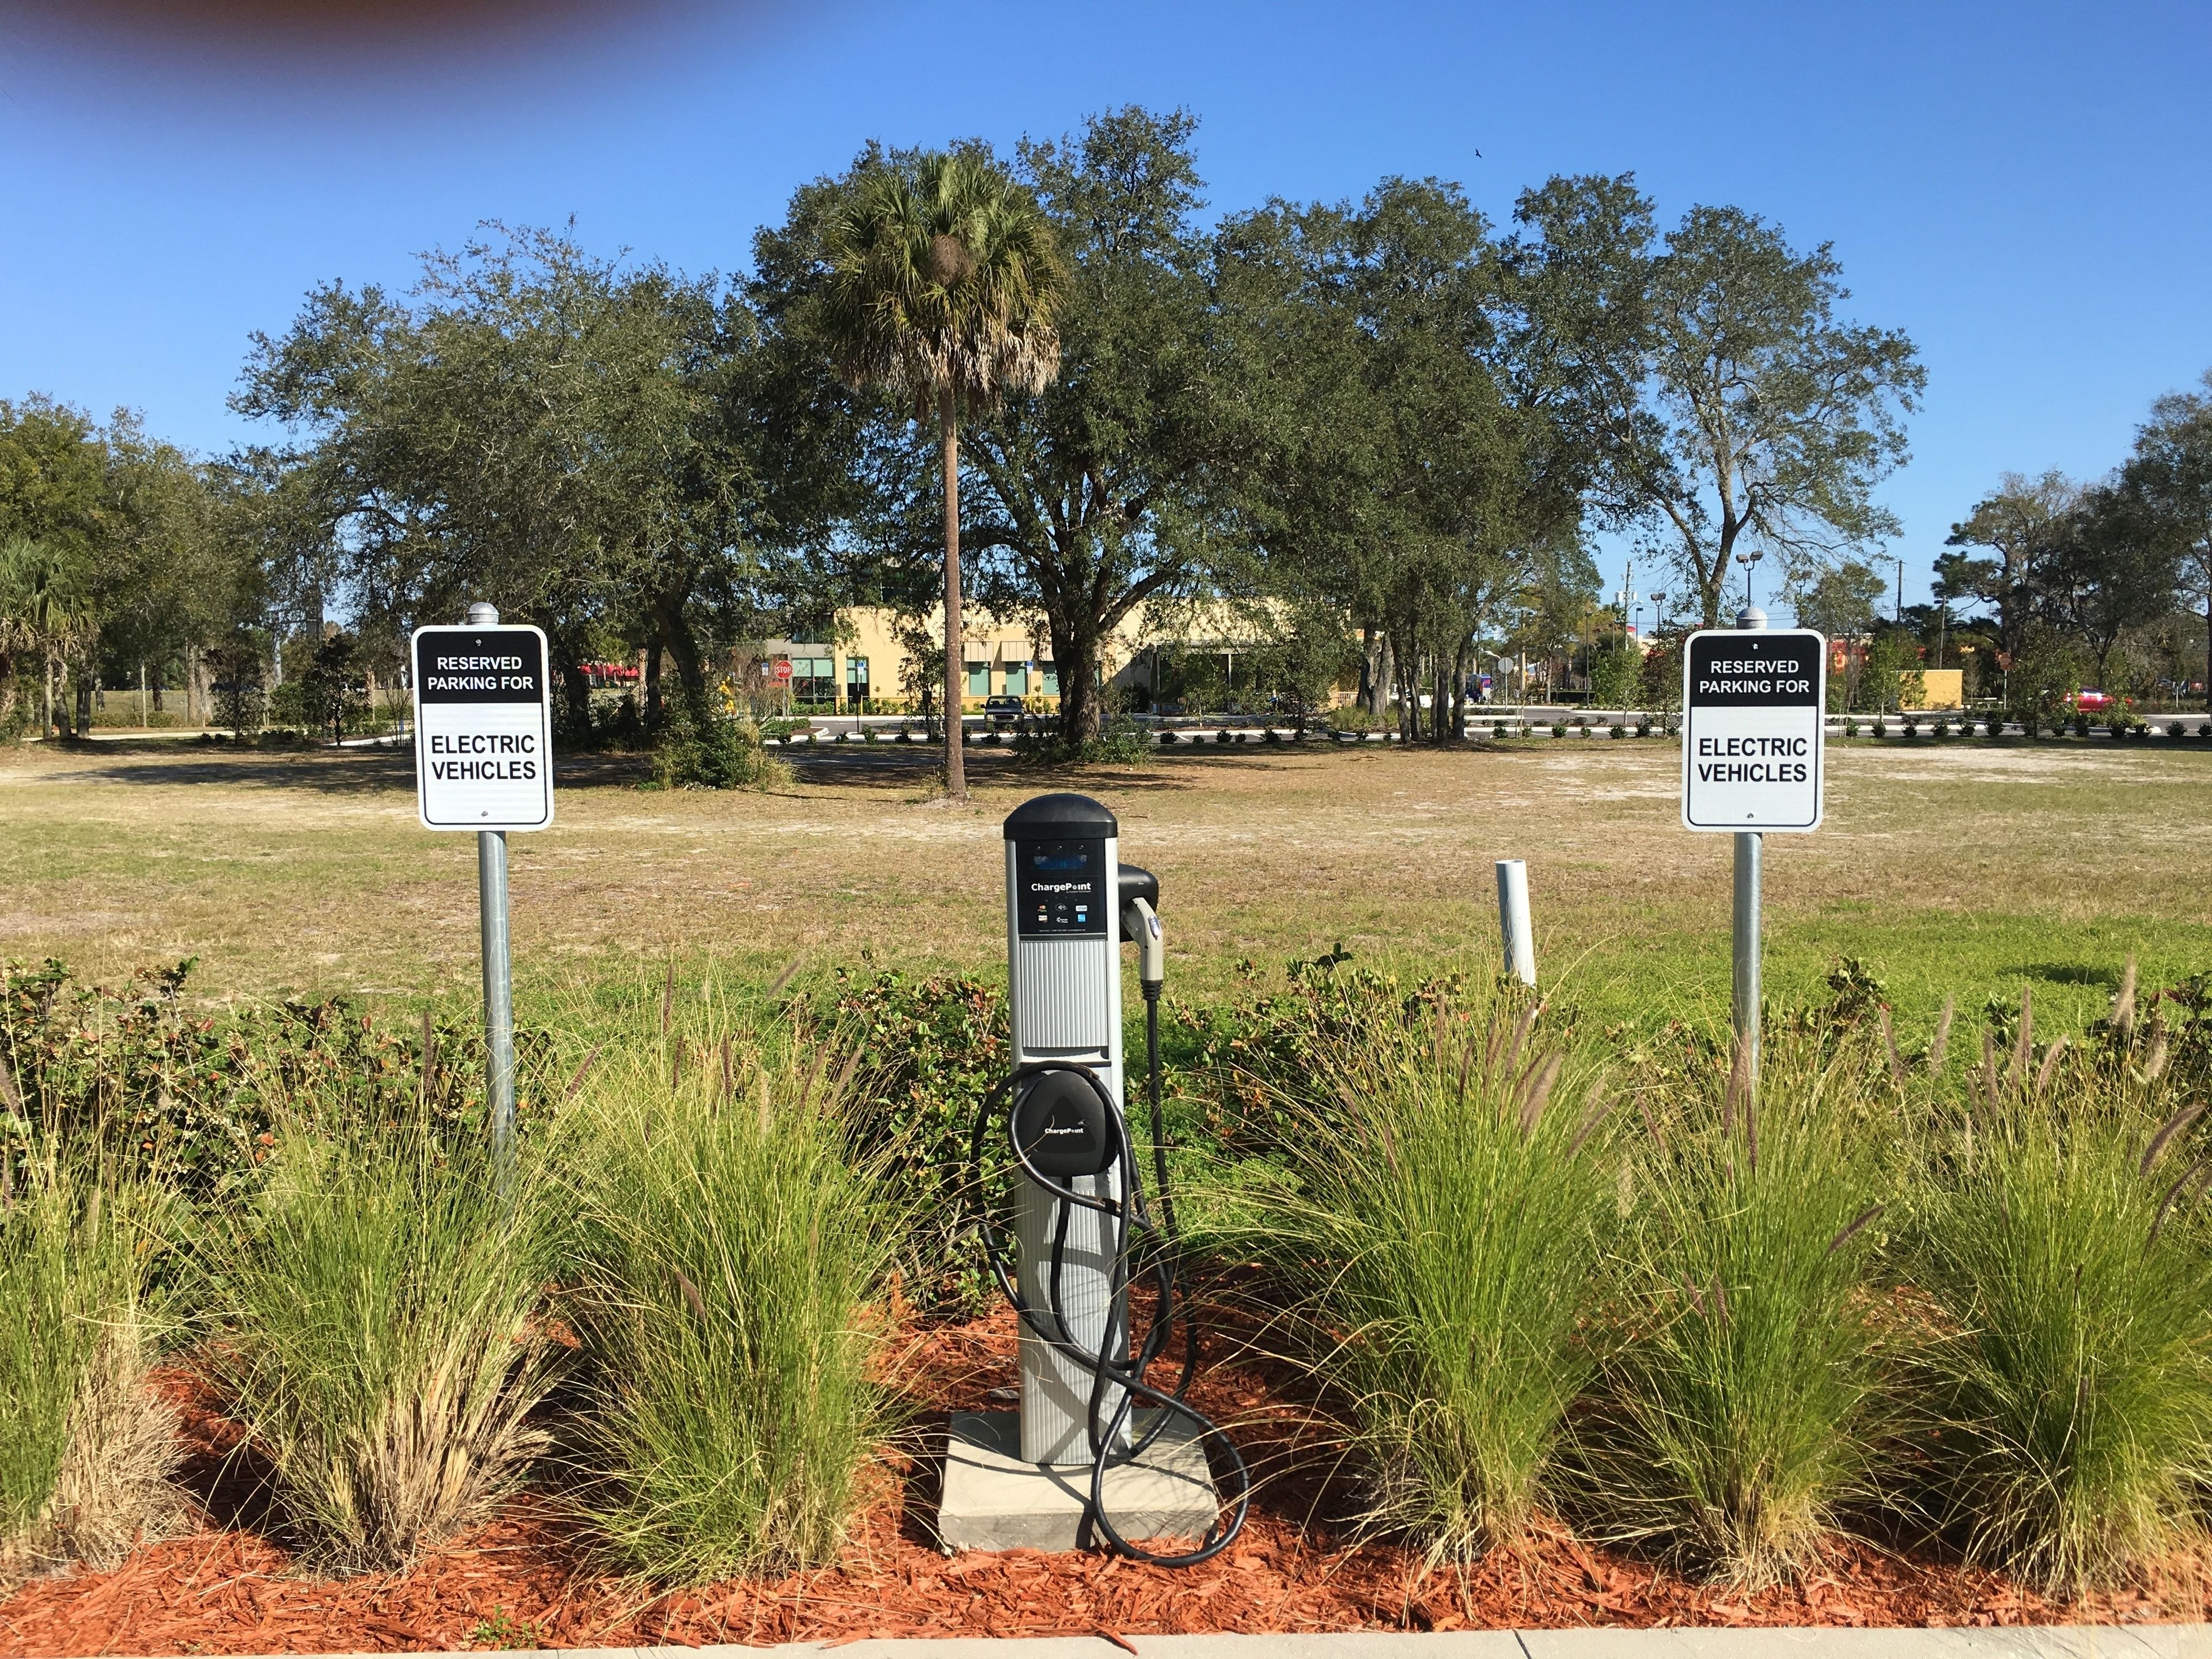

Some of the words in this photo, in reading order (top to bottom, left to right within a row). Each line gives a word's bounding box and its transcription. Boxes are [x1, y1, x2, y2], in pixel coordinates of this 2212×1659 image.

[437, 657, 522, 671] RESERVED
[1710, 660, 1799, 673] RESERVED
[428, 676, 497, 690] PARKING
[501, 676, 534, 690] FOR
[1699, 680, 1771, 693] PARKING
[1776, 680, 1810, 693] FOR
[431, 734, 535, 754] ELECTRIC
[1699, 737, 1808, 756] ELECTRIC
[431, 761, 536, 780] VEHICLES
[1698, 763, 1807, 782] VEHICLES
[1031, 882, 1092, 892] ChargePoint
